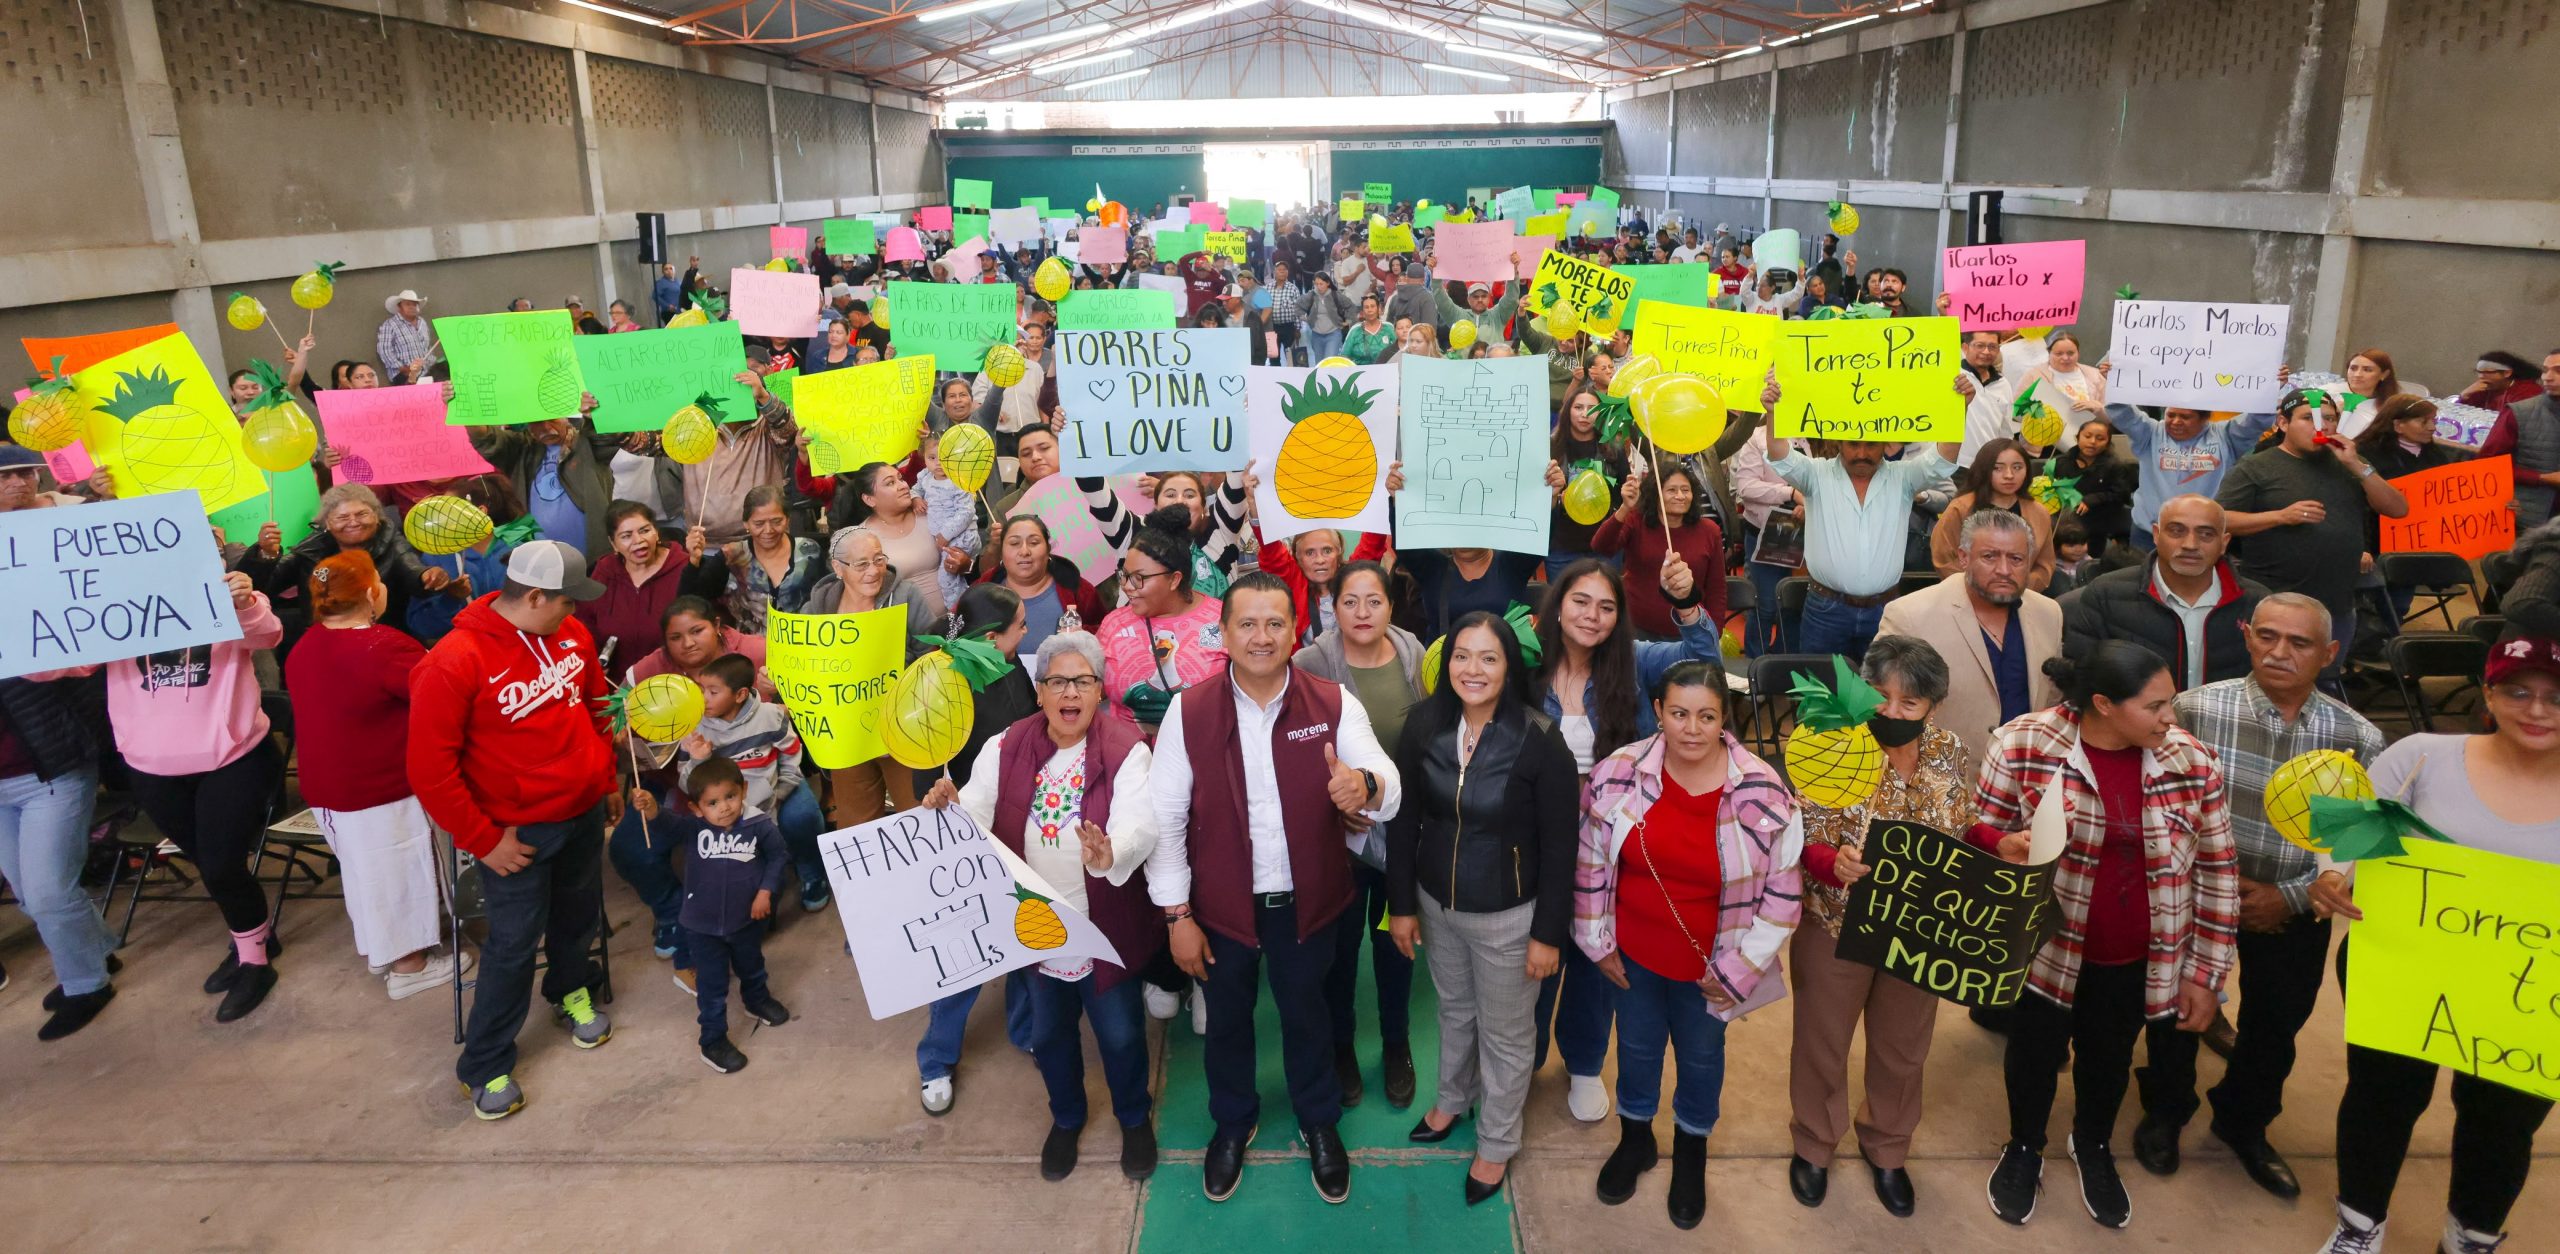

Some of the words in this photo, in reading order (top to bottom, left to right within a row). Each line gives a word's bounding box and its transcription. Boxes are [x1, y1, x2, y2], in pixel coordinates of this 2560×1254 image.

[1231, 245, 1245, 256] YOU
[1542, 252, 1631, 301] MORELOS
[1570, 283, 1590, 304] TE
[1971, 267, 2029, 288] hazlo
[950, 292, 972, 314] DE
[1063, 311, 1110, 326] CONTIGO
[1089, 293, 1138, 311] CARLOS
[1964, 300, 2076, 324] Michoacán!
[456, 319, 574, 348] GOBERNADOR
[902, 318, 941, 340] COMO
[2205, 306, 2278, 338] Morelos
[597, 337, 708, 371] ALFAREROS
[1056, 330, 1192, 368] TORRES
[1652, 322, 1718, 355] Torres
[1720, 325, 1758, 360] Piña
[1787, 334, 1881, 373] Torres
[1883, 325, 1942, 370] Piña
[2123, 333, 2141, 357] te
[2149, 339, 2213, 365] apoya!
[607, 373, 675, 407] TORRES
[679, 364, 739, 397] PIÑA
[1125, 367, 1210, 409] PIÑA
[1849, 372, 1881, 405] te
[2112, 367, 2122, 389] I
[2138, 369, 2185, 391] Love
[2192, 371, 2203, 391] U
[1072, 420, 1092, 460] I
[1103, 416, 1192, 458] LOVE
[1210, 415, 1233, 453] U
[1800, 402, 1934, 439] Apoyamos
[2423, 470, 2498, 508] PUEBLO
[0, 536, 27, 571] L
[53, 516, 182, 563] PUEBLO
[59, 568, 101, 601] TE
[782, 654, 853, 673] CONTIGO
[498, 652, 585, 722] Dodgers
[828, 669, 899, 707] TORRES
[1287, 721, 1330, 741] morena
[930, 853, 1006, 898] con
[1882, 825, 1974, 879] QUE
[1984, 869, 2042, 898] SE
[1873, 858, 1928, 898] DE
[1933, 889, 2013, 934] QUE
[1868, 888, 2009, 965] HECHOS
